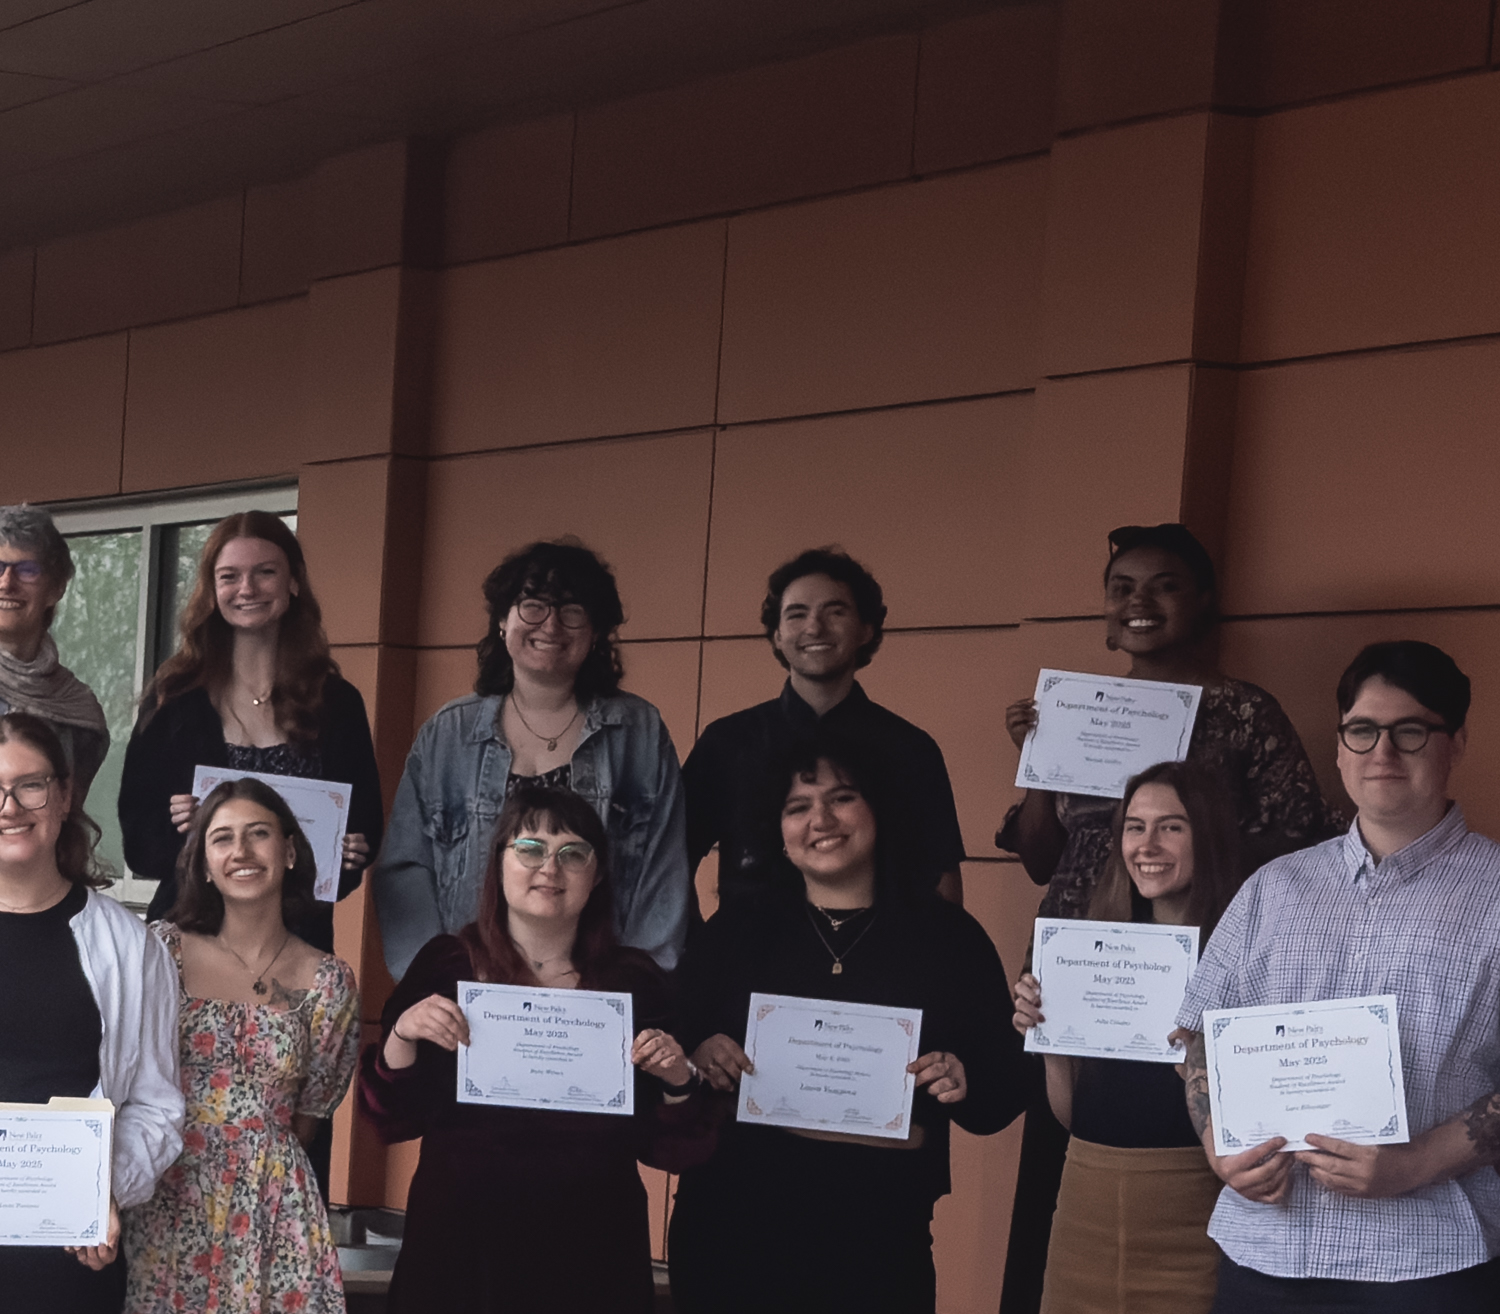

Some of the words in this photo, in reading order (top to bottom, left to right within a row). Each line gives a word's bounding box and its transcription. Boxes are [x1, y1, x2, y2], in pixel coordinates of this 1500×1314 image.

[1055, 955, 1109, 967] Department
[1112, 959, 1121, 968] of
[1123, 959, 1171, 972] Psychology
[1092, 973, 1112, 984] May
[483, 1010, 540, 1022] Department
[554, 1016, 605, 1028] Psychology
[524, 1027, 543, 1037] May
[546, 1030, 568, 1038] 2025
[1233, 1041, 1295, 1054] Department
[1298, 1038, 1308, 1048] of
[1311, 1035, 1368, 1048] Psychology
[1279, 1058, 1300, 1067] May
[1303, 1055, 1327, 1065] 2025
[17, 1143, 27, 1152] of
[30, 1144, 82, 1154] Psychology
[20, 1160, 42, 1168] 2025
